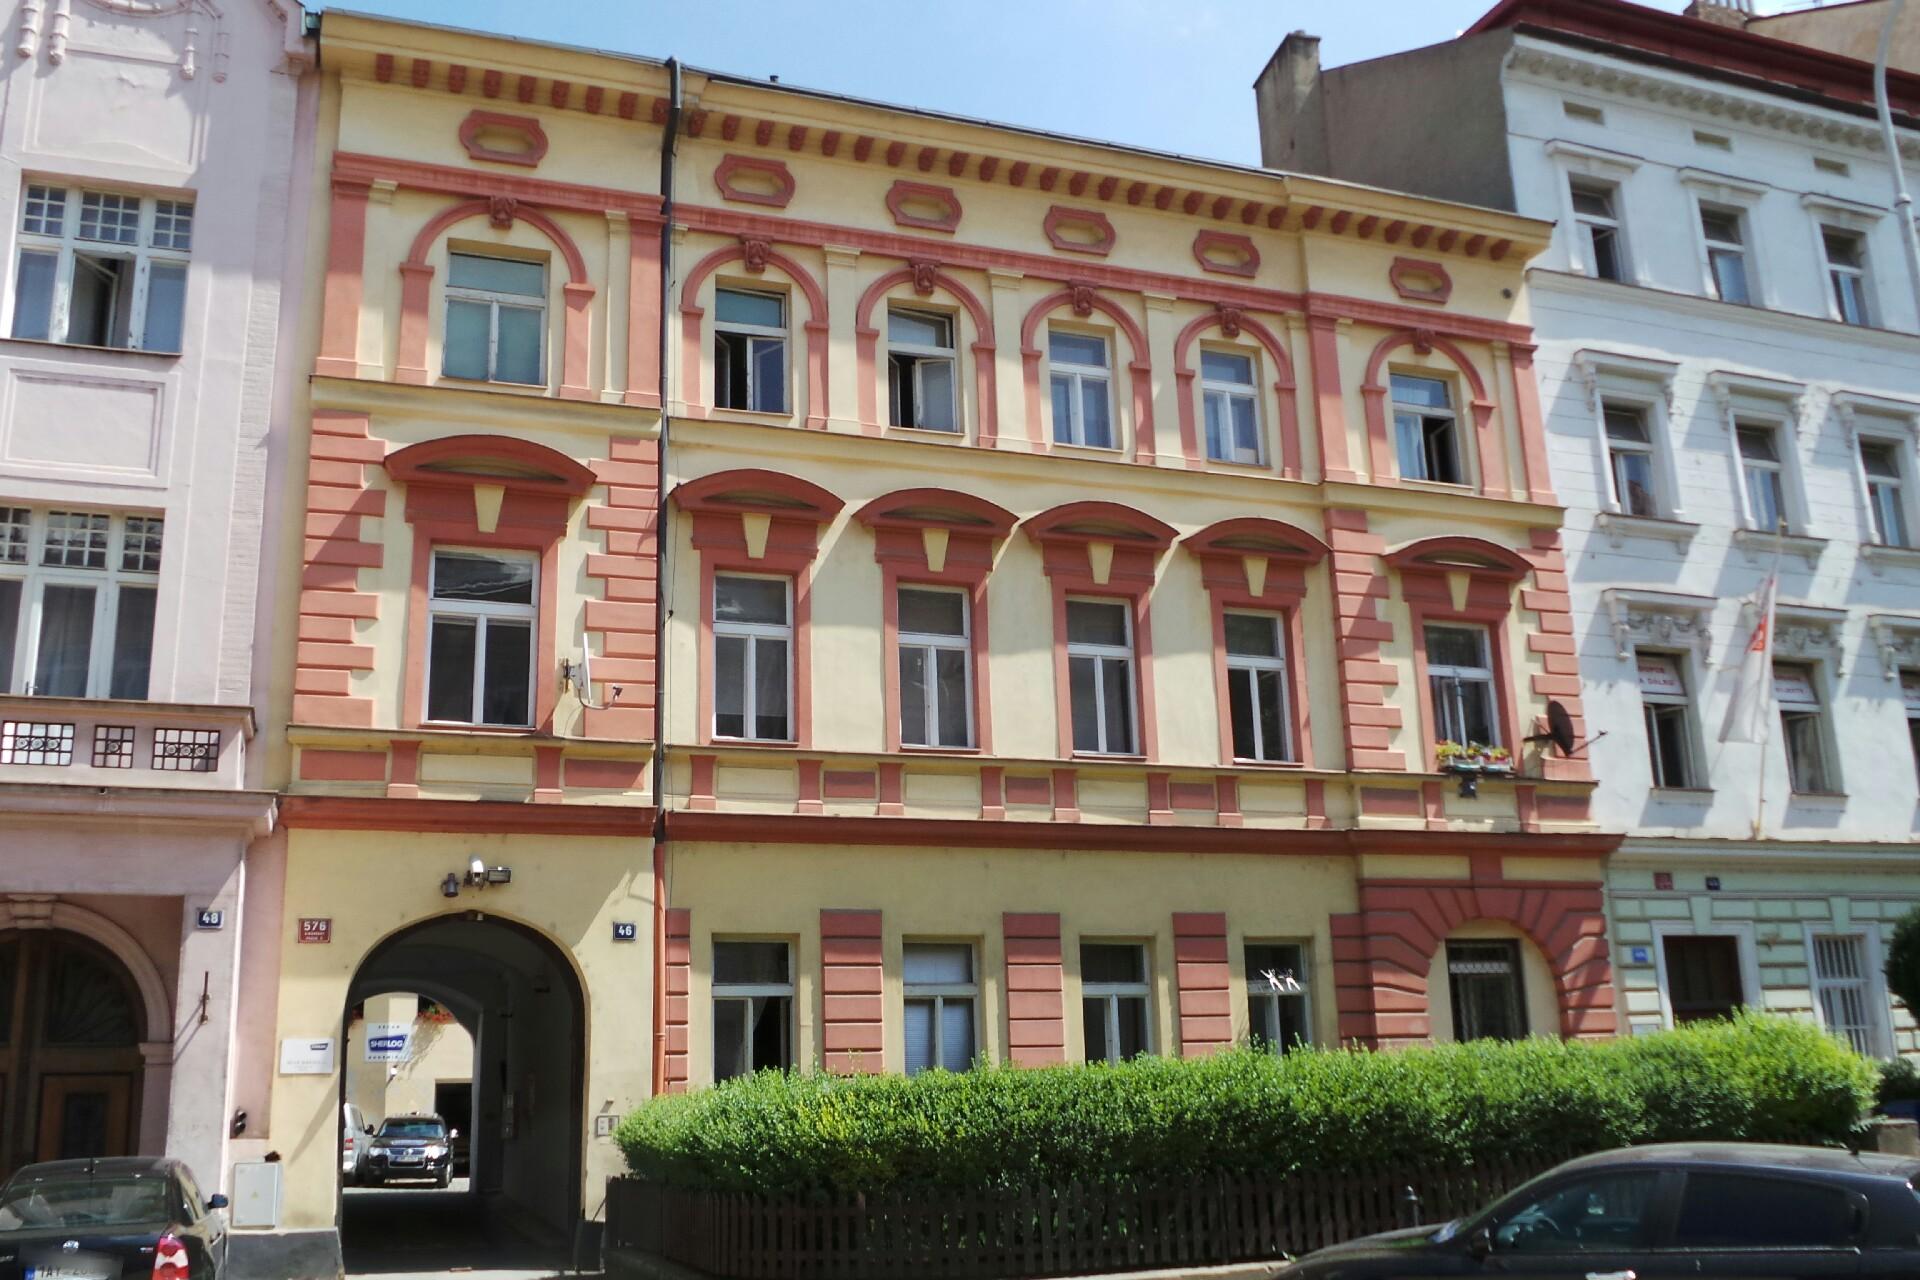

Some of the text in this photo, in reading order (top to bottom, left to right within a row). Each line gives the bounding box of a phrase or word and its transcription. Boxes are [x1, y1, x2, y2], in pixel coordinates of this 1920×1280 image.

[202, 912, 219, 924] 48
[303, 920, 326, 931] 576
[618, 925, 632, 936] 46
[370, 1039, 404, 1049] SHERLOG
